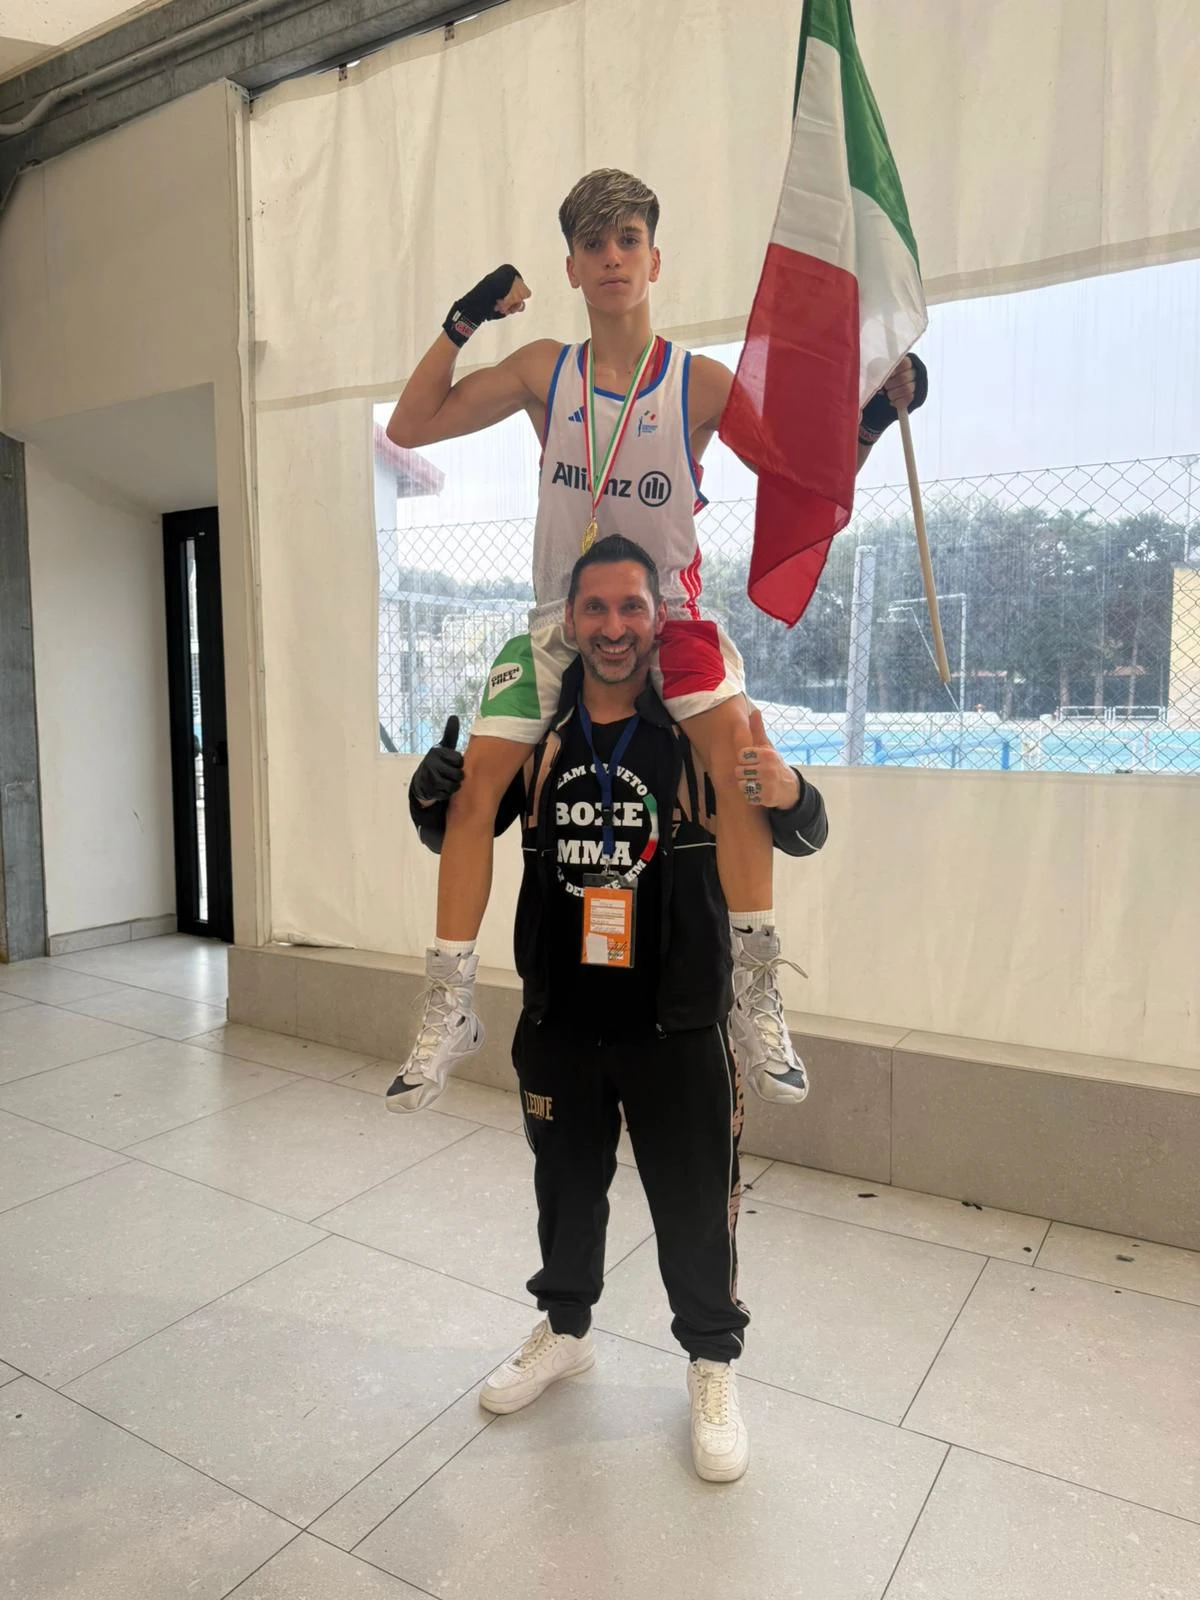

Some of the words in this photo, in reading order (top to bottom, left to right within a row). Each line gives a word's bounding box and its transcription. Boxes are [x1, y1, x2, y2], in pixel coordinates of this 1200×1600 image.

[552, 461, 632, 498] Allinz
[491, 666, 520, 682] GREEN
[492, 674, 517, 687] HILL
[557, 764, 587, 790] EAM
[556, 801, 644, 827] BOXE
[557, 839, 633, 866] MMA
